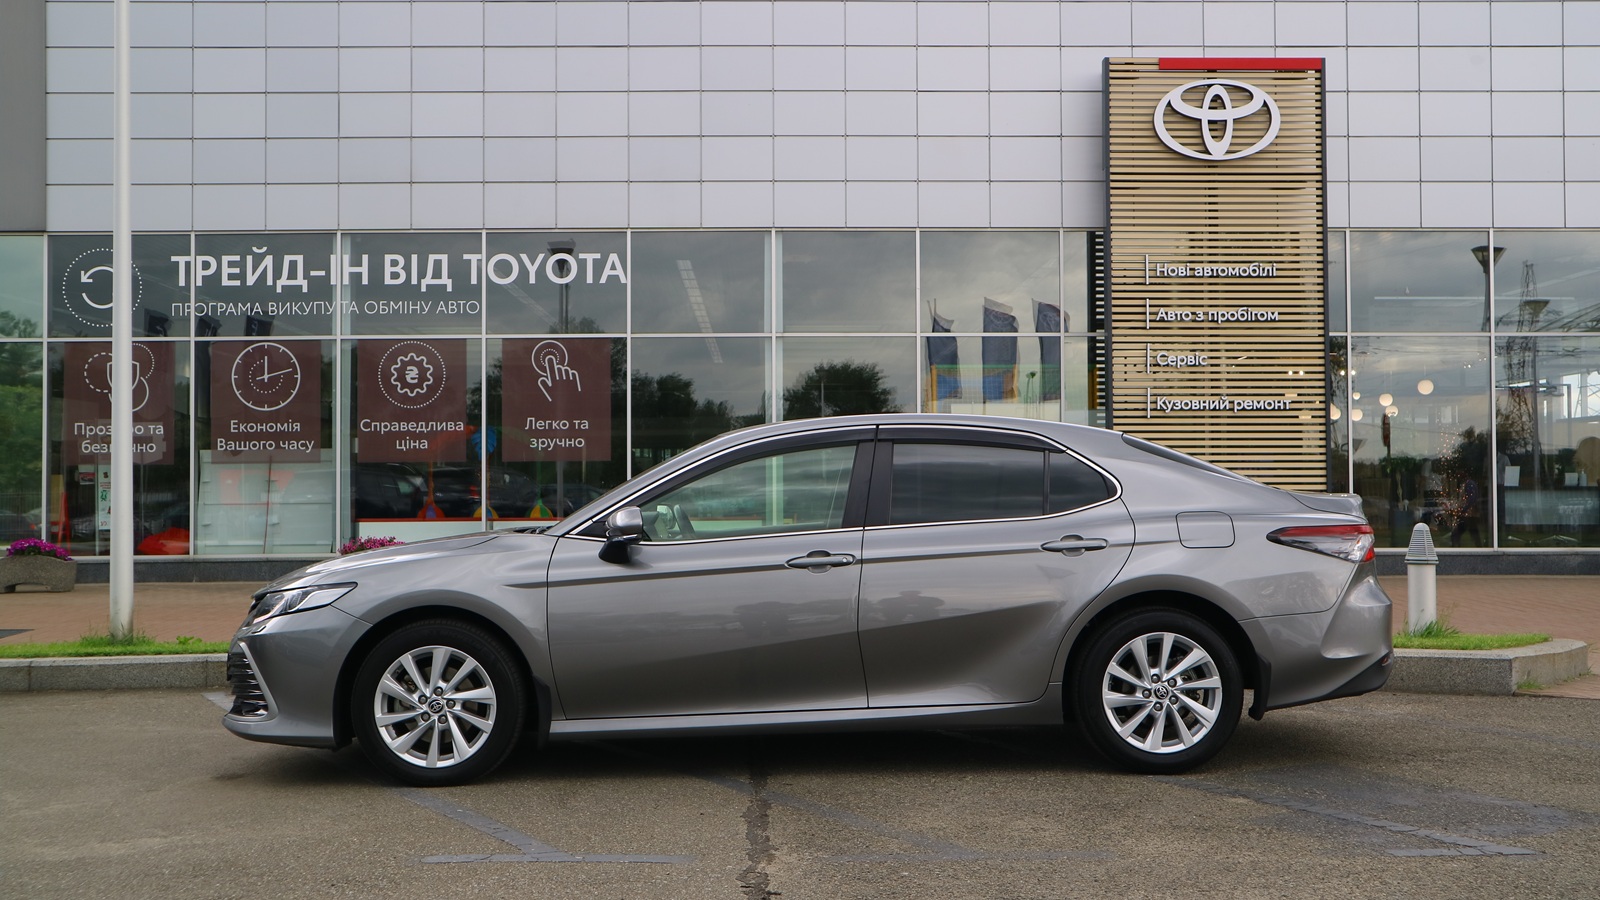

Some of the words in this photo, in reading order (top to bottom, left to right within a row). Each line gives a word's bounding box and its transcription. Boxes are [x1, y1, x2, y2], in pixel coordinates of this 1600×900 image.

[171, 246, 368, 292] ТРЕЙД-ІН
[384, 254, 452, 291] ВІД
[463, 252, 627, 284] TOYOTA
[1156, 263, 1190, 277] Нові
[1194, 263, 1277, 277] автомобілі
[171, 302, 263, 316] ПРОГРАМА
[268, 301, 336, 315] ВИКУПУ
[340, 300, 360, 314] ТА
[364, 300, 432, 314] ОБМІНУ
[436, 300, 480, 314] АВТО
[1156, 308, 1192, 321] Авто
[1196, 312, 1204, 321] з
[1208, 307, 1279, 324] пробігом
[1156, 352, 1208, 368] Сервіс
[1156, 396, 1230, 412] Кузовний
[1234, 399, 1292, 413] ремонт
[74, 422, 145, 438] Прозо
[148, 424, 164, 435] та
[230, 420, 301, 433] Економія
[360, 419, 465, 434] Справедлива
[525, 417, 569, 430] Легко
[573, 420, 589, 430] та
[81, 440, 157, 453] безчно
[217, 438, 276, 451] Вашого
[280, 440, 314, 453] часу
[396, 436, 428, 450] ціна
[529, 438, 585, 450] зручно
